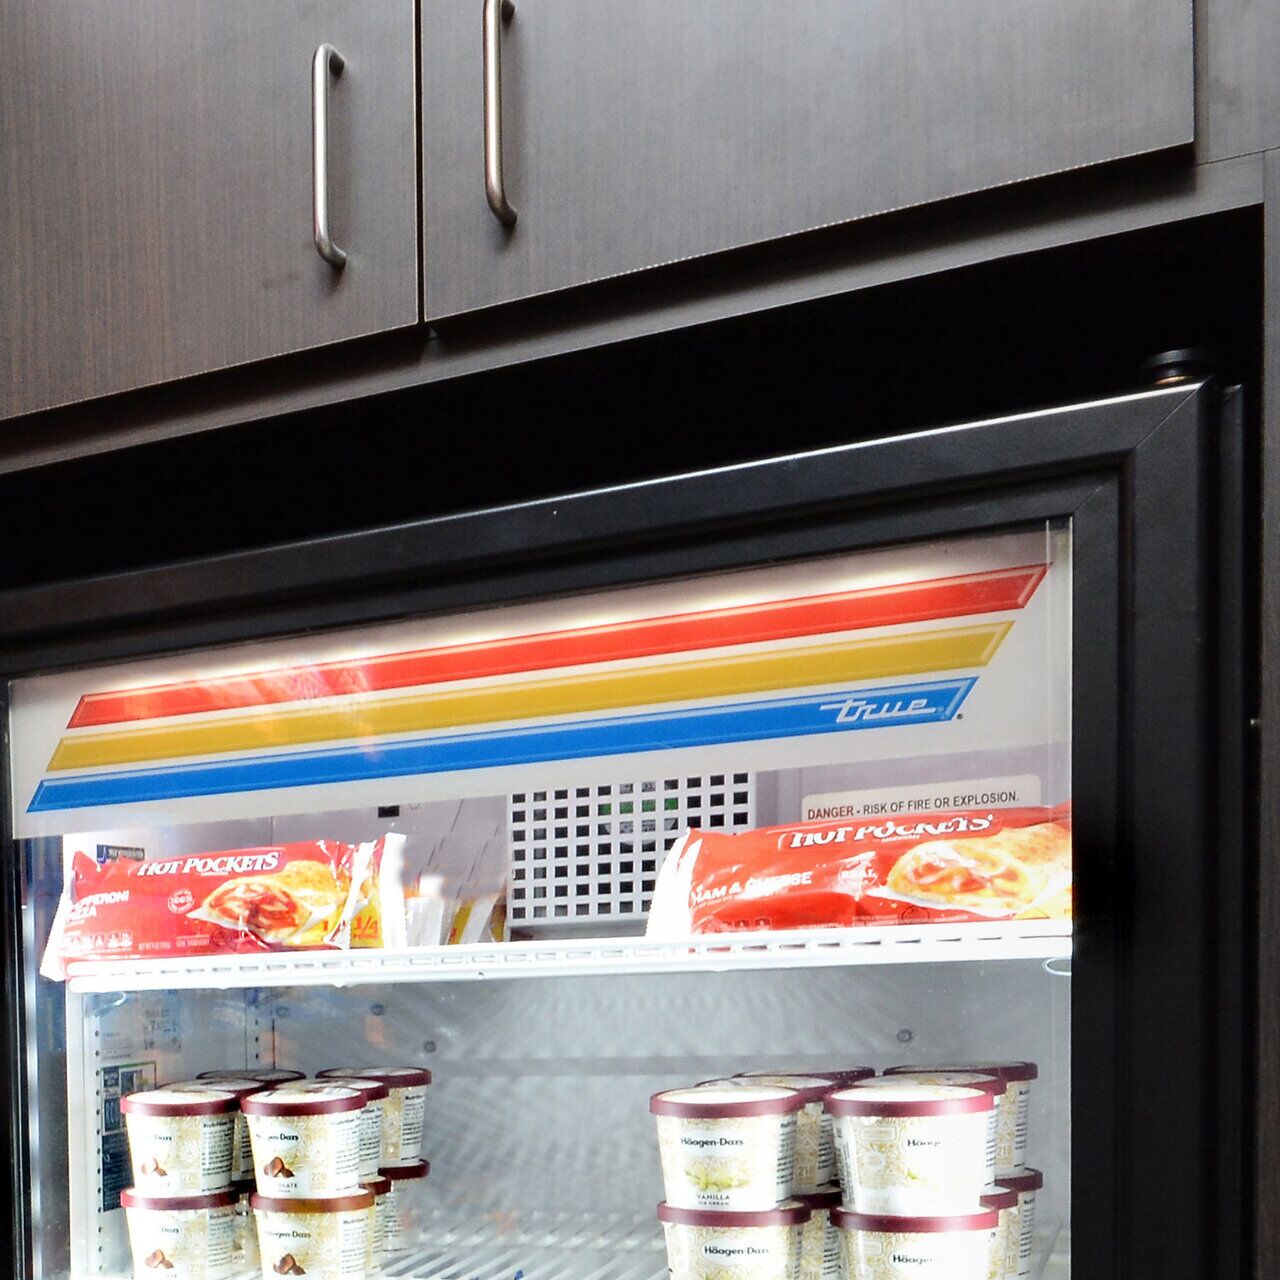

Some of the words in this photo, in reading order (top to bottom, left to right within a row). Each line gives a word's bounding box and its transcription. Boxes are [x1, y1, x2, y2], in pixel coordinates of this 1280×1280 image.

[820, 699, 937, 723] true
[807, 805, 854, 820] DANGER
[863, 802, 887, 815] RISK
[890, 801, 905, 812] OF
[907, 798, 931, 810] FIRE
[934, 797, 950, 808] OR
[953, 791, 1019, 806] EXPLOSION.
[138, 861, 182, 876] HOT
[184, 851, 280, 874] POCKETS
[353, 918, 378, 934] 1/4
[680, 1135, 744, 1148] Häagen-Dazs
